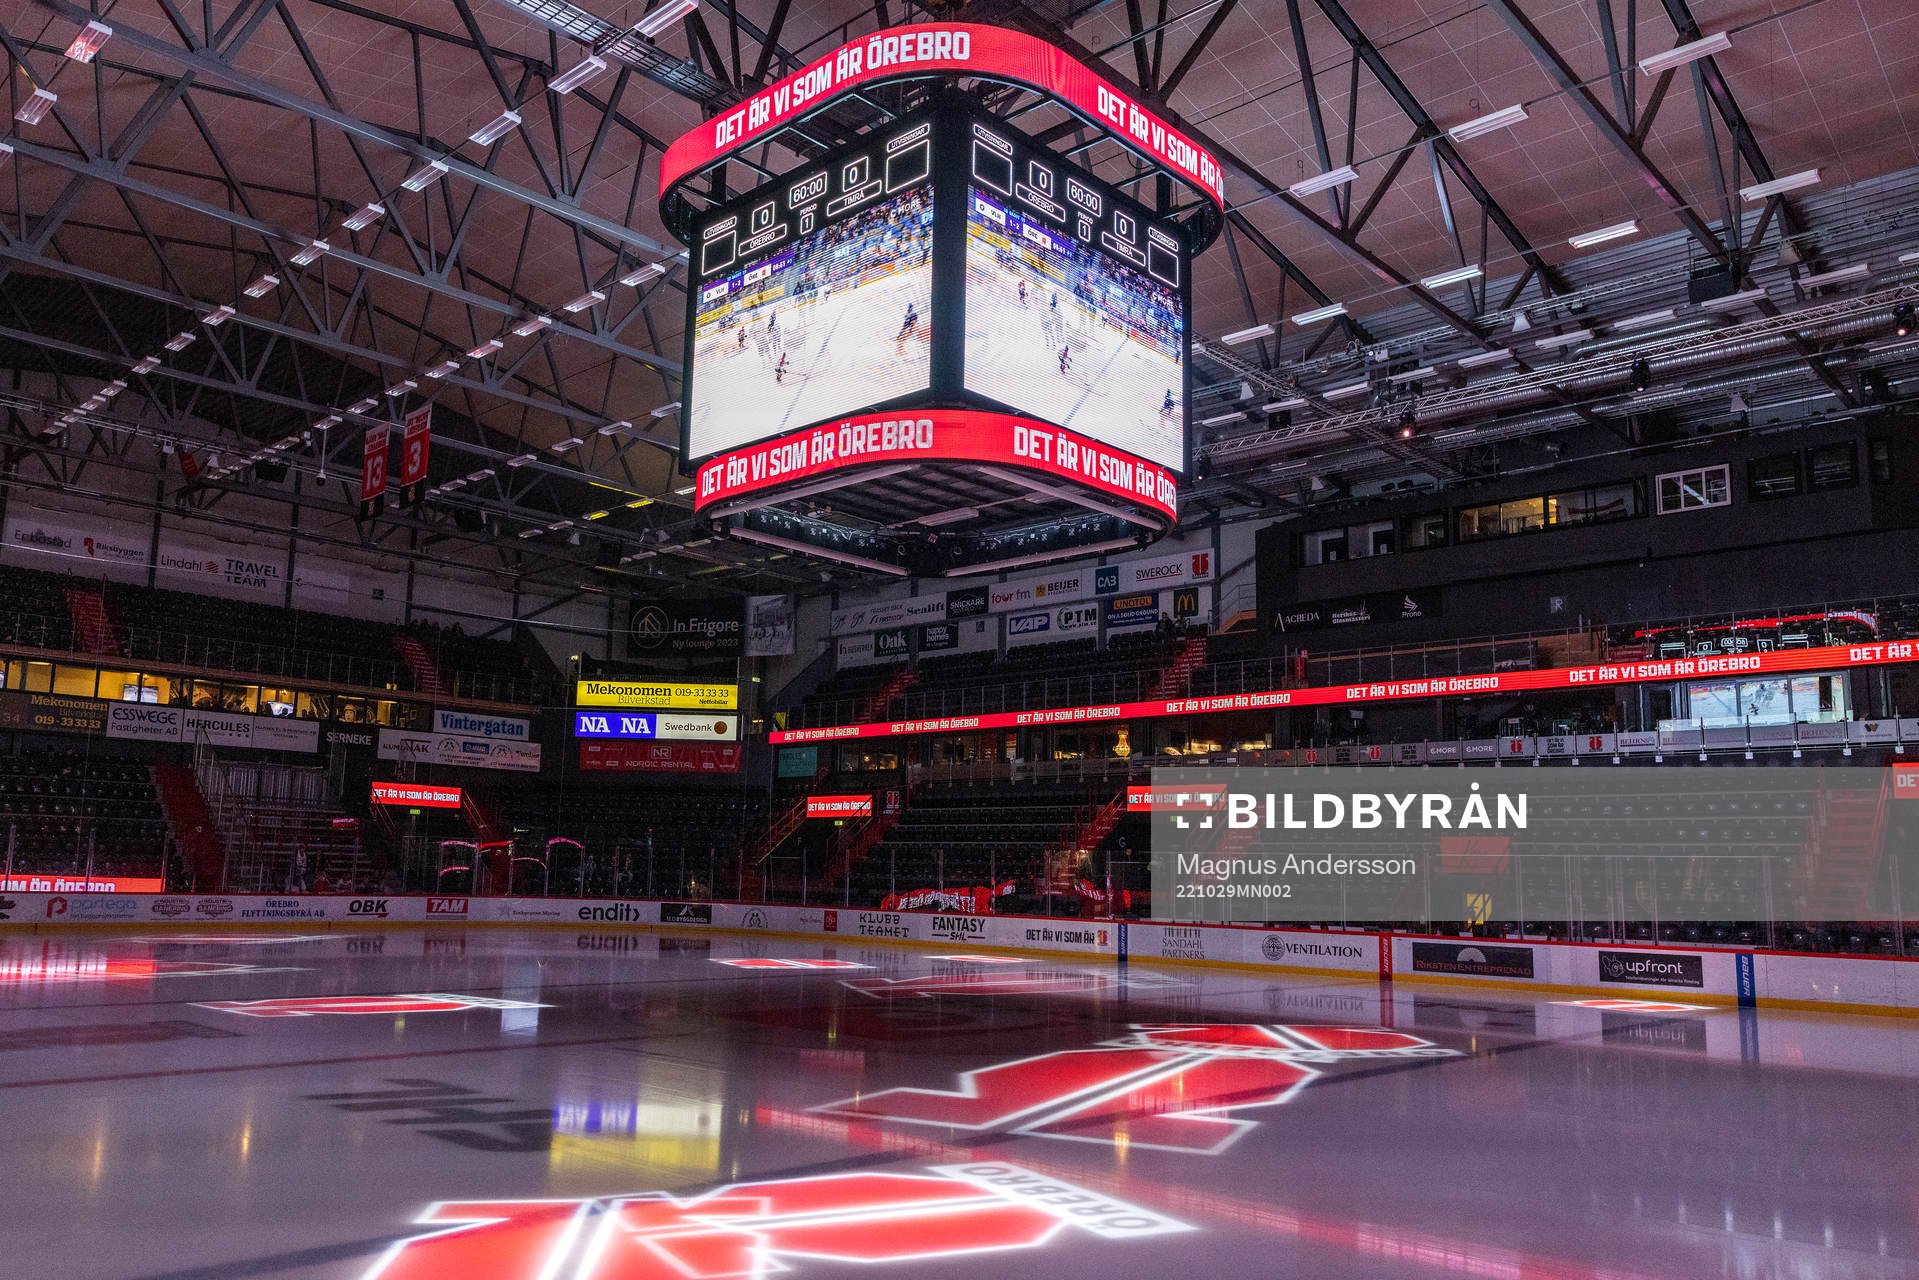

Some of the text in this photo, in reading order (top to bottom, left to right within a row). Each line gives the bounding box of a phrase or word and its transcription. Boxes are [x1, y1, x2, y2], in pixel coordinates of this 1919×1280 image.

[715, 31, 970, 149] DET ÄR VI SOM ÄR ÖREBRO
[1098, 85, 1126, 127] DET
[1129, 103, 1148, 144] ÄR
[1151, 122, 1165, 155] VI
[1168, 134, 1197, 176] SOM
[1200, 152, 1215, 190] ÄR
[850, 167, 858, 183] 0
[1040, 174, 1047, 188] 0
[793, 178, 823, 202] 60:00
[1071, 185, 1098, 210] 60:00
[844, 191, 864, 206] TIMRÅ
[1028, 193, 1054, 213] ÖREBRO
[761, 209, 769, 224] 0
[1120, 219, 1126, 234] 0
[749, 232, 775, 248] ÖREBRO
[1115, 241, 1133, 257] TIMRÅ
[408, 440, 421, 475] 3
[702, 419, 933, 498] DET ÄR VI SOM ÄR ÖREBRO
[1014, 425, 1155, 498] DET ÄR VI SOM ÄR
[366, 455, 383, 490] 13
[96, 542, 144, 557] Riksbyggen
[161, 555, 202, 571] Lindahl
[225, 558, 279, 578] TRAVEL
[225, 571, 266, 588] TEAM
[1136, 563, 1183, 580] SWEROCK
[1048, 579, 1079, 591] BEIJER
[1016, 589, 1030, 600] fm
[906, 602, 945, 616] Sealift
[950, 597, 985, 610] SNICKARE
[1064, 608, 1097, 624] PTM
[674, 618, 739, 637] In Frigore
[673, 638, 739, 650] Ny lounge 2023
[879, 631, 908, 649] Oak
[1849, 646, 1884, 661] DET
[1887, 643, 1912, 658] ÄR
[1569, 656, 1761, 682] DET ÄR VI SOM ÄR ÖREBRO
[587, 683, 729, 698] Mekonomen 019-33 33 33
[1346, 677, 1498, 699] DET ÄR VI SOM ÄR ÖREBRO
[31, 695, 108, 711] Mekonomen
[618, 695, 671, 706] Bilverkstad
[1166, 693, 1291, 713] DET ÄR VI SOM ÄR ÖREBRO
[113, 708, 177, 725] ESSWEGE
[1017, 707, 1121, 723] DET ÄR VI SOM ÄR ÖREBRO
[111, 722, 178, 735] Fastigheter AB
[186, 718, 250, 733] HERCULES
[441, 712, 524, 736] Vintergatan
[580, 716, 651, 734] NA NA
[665, 723, 712, 732] Swedbank
[892, 724, 904, 732] DET
[905, 722, 914, 731] ÄR
[923, 721, 939, 730] SOM
[940, 720, 950, 728] ÄR
[950, 718, 979, 728] ÖREBRO
[326, 732, 373, 746] SERNEKE
[661, 761, 696, 769] RENTAL
[373, 789, 459, 802] DET ÄR VI SOM ÄR ÖREBRO
[1128, 793, 1154, 804] DET ÄR
[30, 878, 115, 892] ÄR ÖREBRO
[265, 898, 299, 908] ÖREBRO
[349, 899, 389, 913] OBK
[431, 899, 465, 912] TAM
[241, 907, 325, 918] FLYTTNINGSBYRÅ AB
[578, 903, 632, 921] endit
[859, 913, 901, 924] KLUBB
[859, 925, 909, 938] TEAMET
[932, 916, 985, 934] FANTASY
[949, 932, 967, 941] SHL
[1026, 928, 1095, 945] DET ÄR VI SOM ÄR
[1162, 937, 1202, 949] SANDAHL
[1161, 948, 1205, 960] PARTNERS
[1286, 942, 1363, 958] VENTILATION
[1626, 960, 1683, 974] upfront
[1742, 955, 1750, 997] BAUER
[959, 1166, 1161, 1230] ÖREBRO
